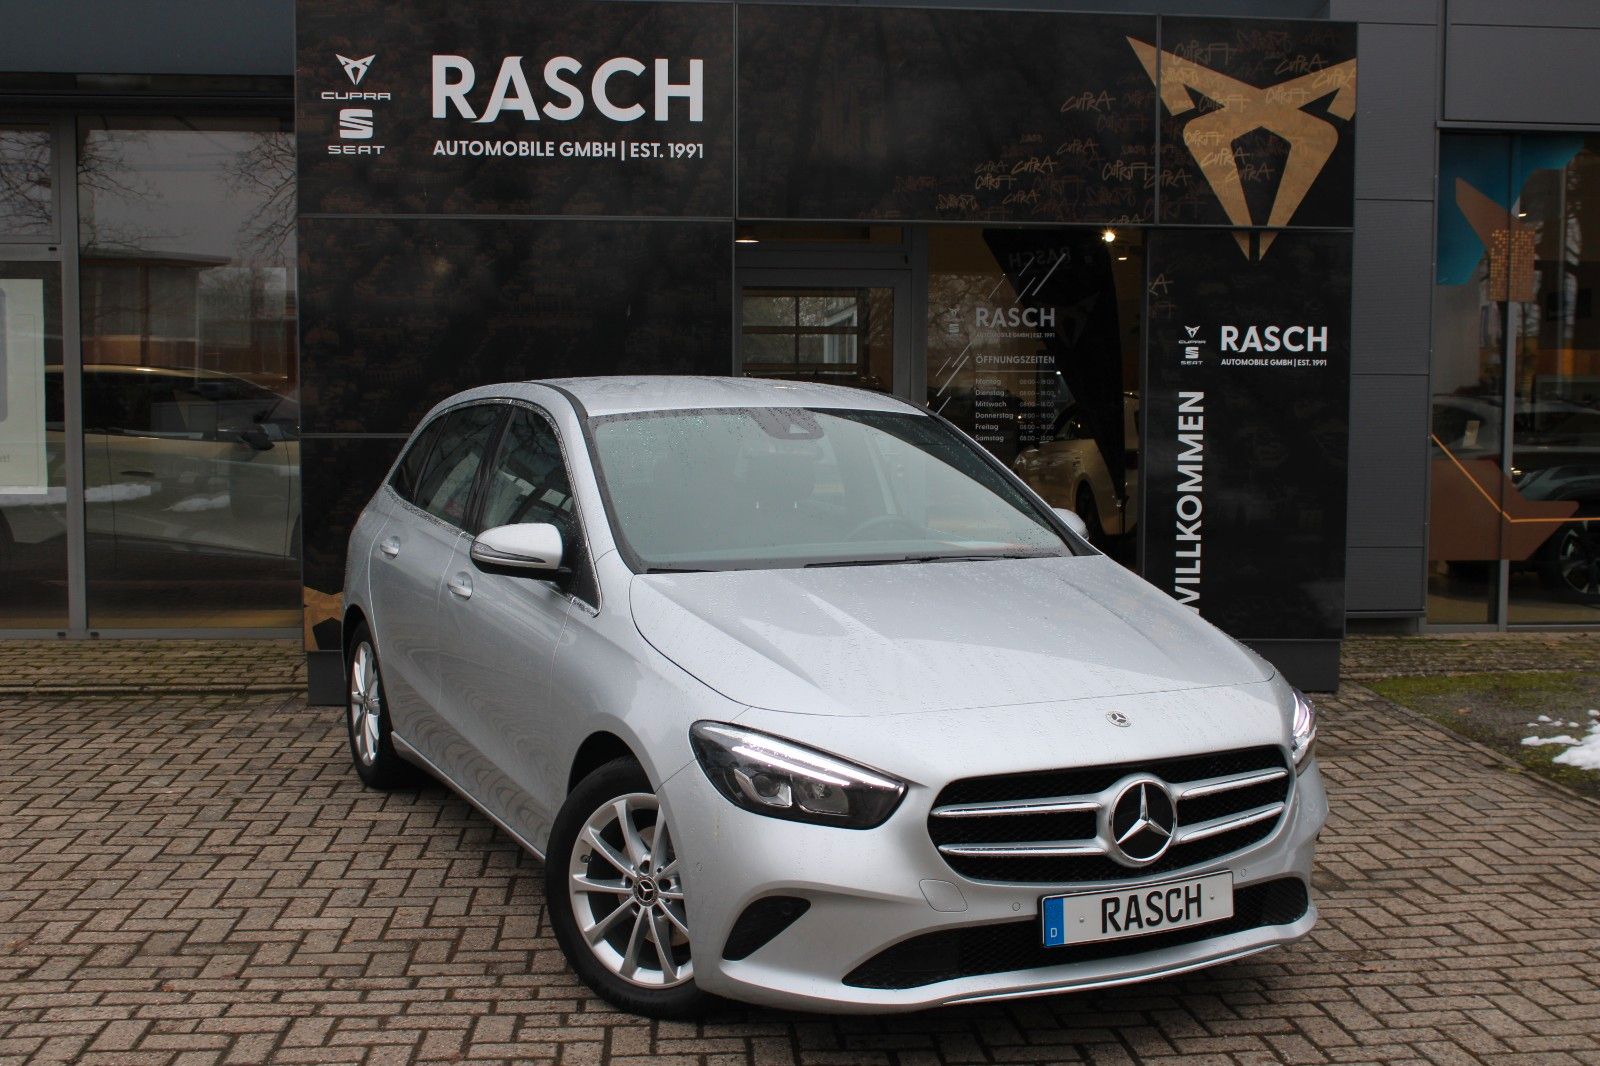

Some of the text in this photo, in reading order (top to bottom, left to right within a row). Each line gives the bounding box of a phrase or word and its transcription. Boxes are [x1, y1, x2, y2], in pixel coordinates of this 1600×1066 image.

[321, 91, 391, 100] CUPRA
[432, 54, 703, 123] RASCH
[1060, 89, 1116, 113] CUPRA
[327, 145, 385, 155] SEAT
[432, 140, 555, 157] AUTOMOBILE
[559, 141, 616, 158] GMBH
[630, 142, 664, 158] EST.
[667, 143, 703, 159] 1991
[975, 306, 1056, 328] RASCH
[1221, 325, 1328, 353] RASCH
[975, 353, 1055, 364] ÖFFNUNGSZEITEN
[975, 412, 1014, 420] Donnerstag
[975, 434, 1005, 442] Samstag
[1174, 391, 1204, 615] WILLKOMMEN
[1050, 883, 1202, 938] D RASCH
